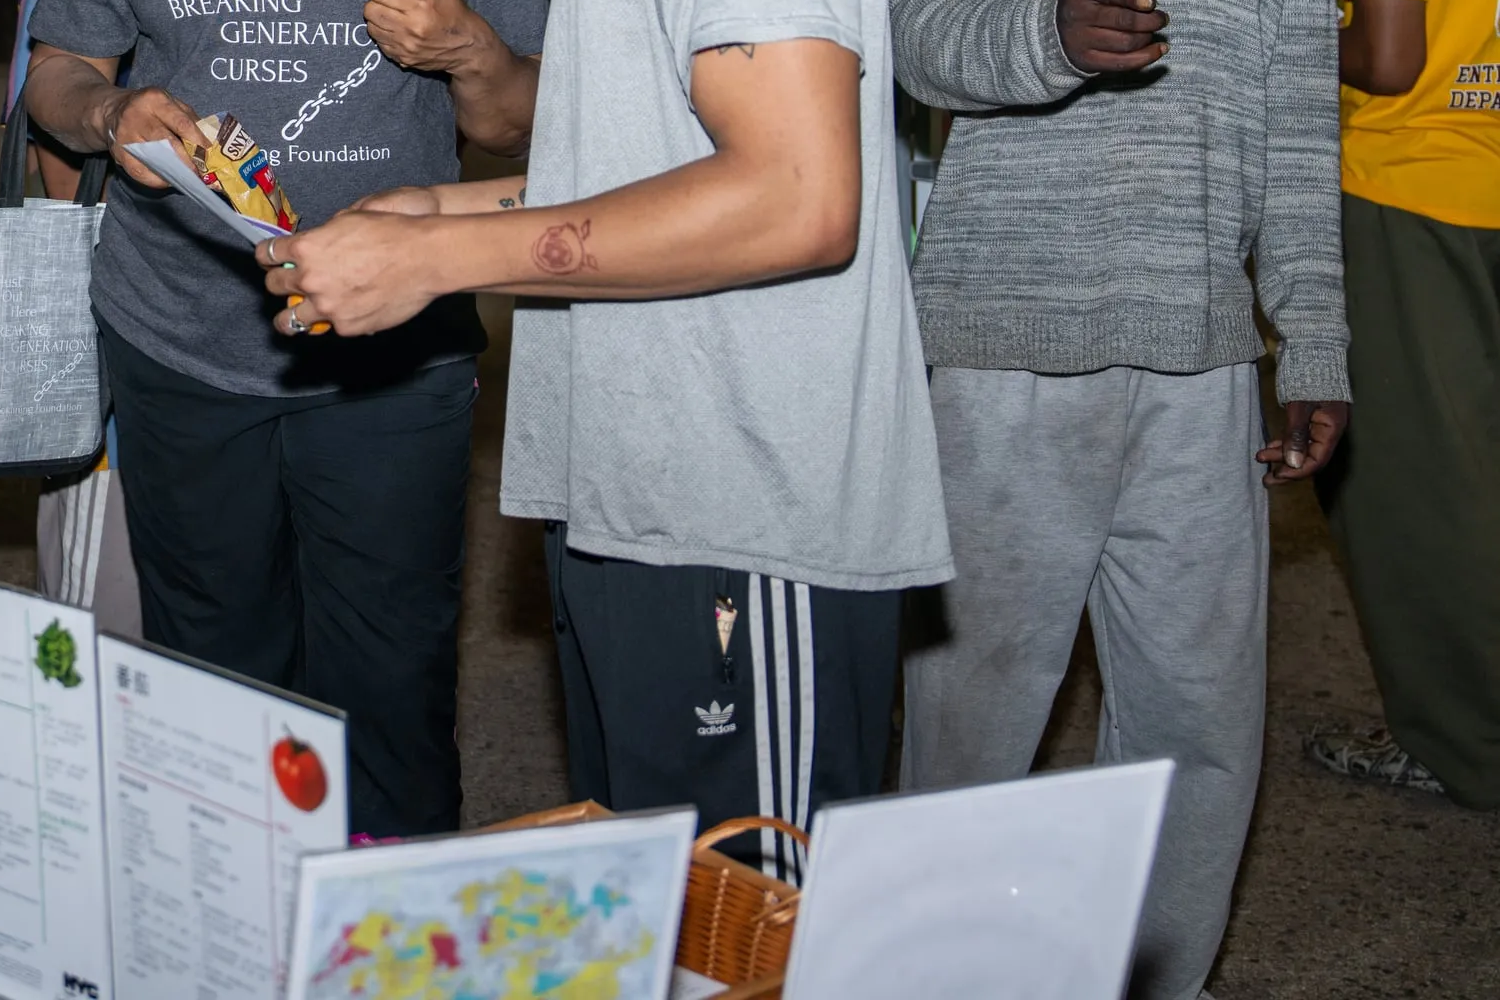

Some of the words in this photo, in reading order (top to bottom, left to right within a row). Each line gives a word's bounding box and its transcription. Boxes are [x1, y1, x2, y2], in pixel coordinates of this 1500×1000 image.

[220, 21, 379, 48] GENERATIO
[210, 56, 309, 83] CURSES
[227, 126, 250, 158] SNY
[288, 144, 391, 163] Foundation
[697, 724, 737, 735] adidas
